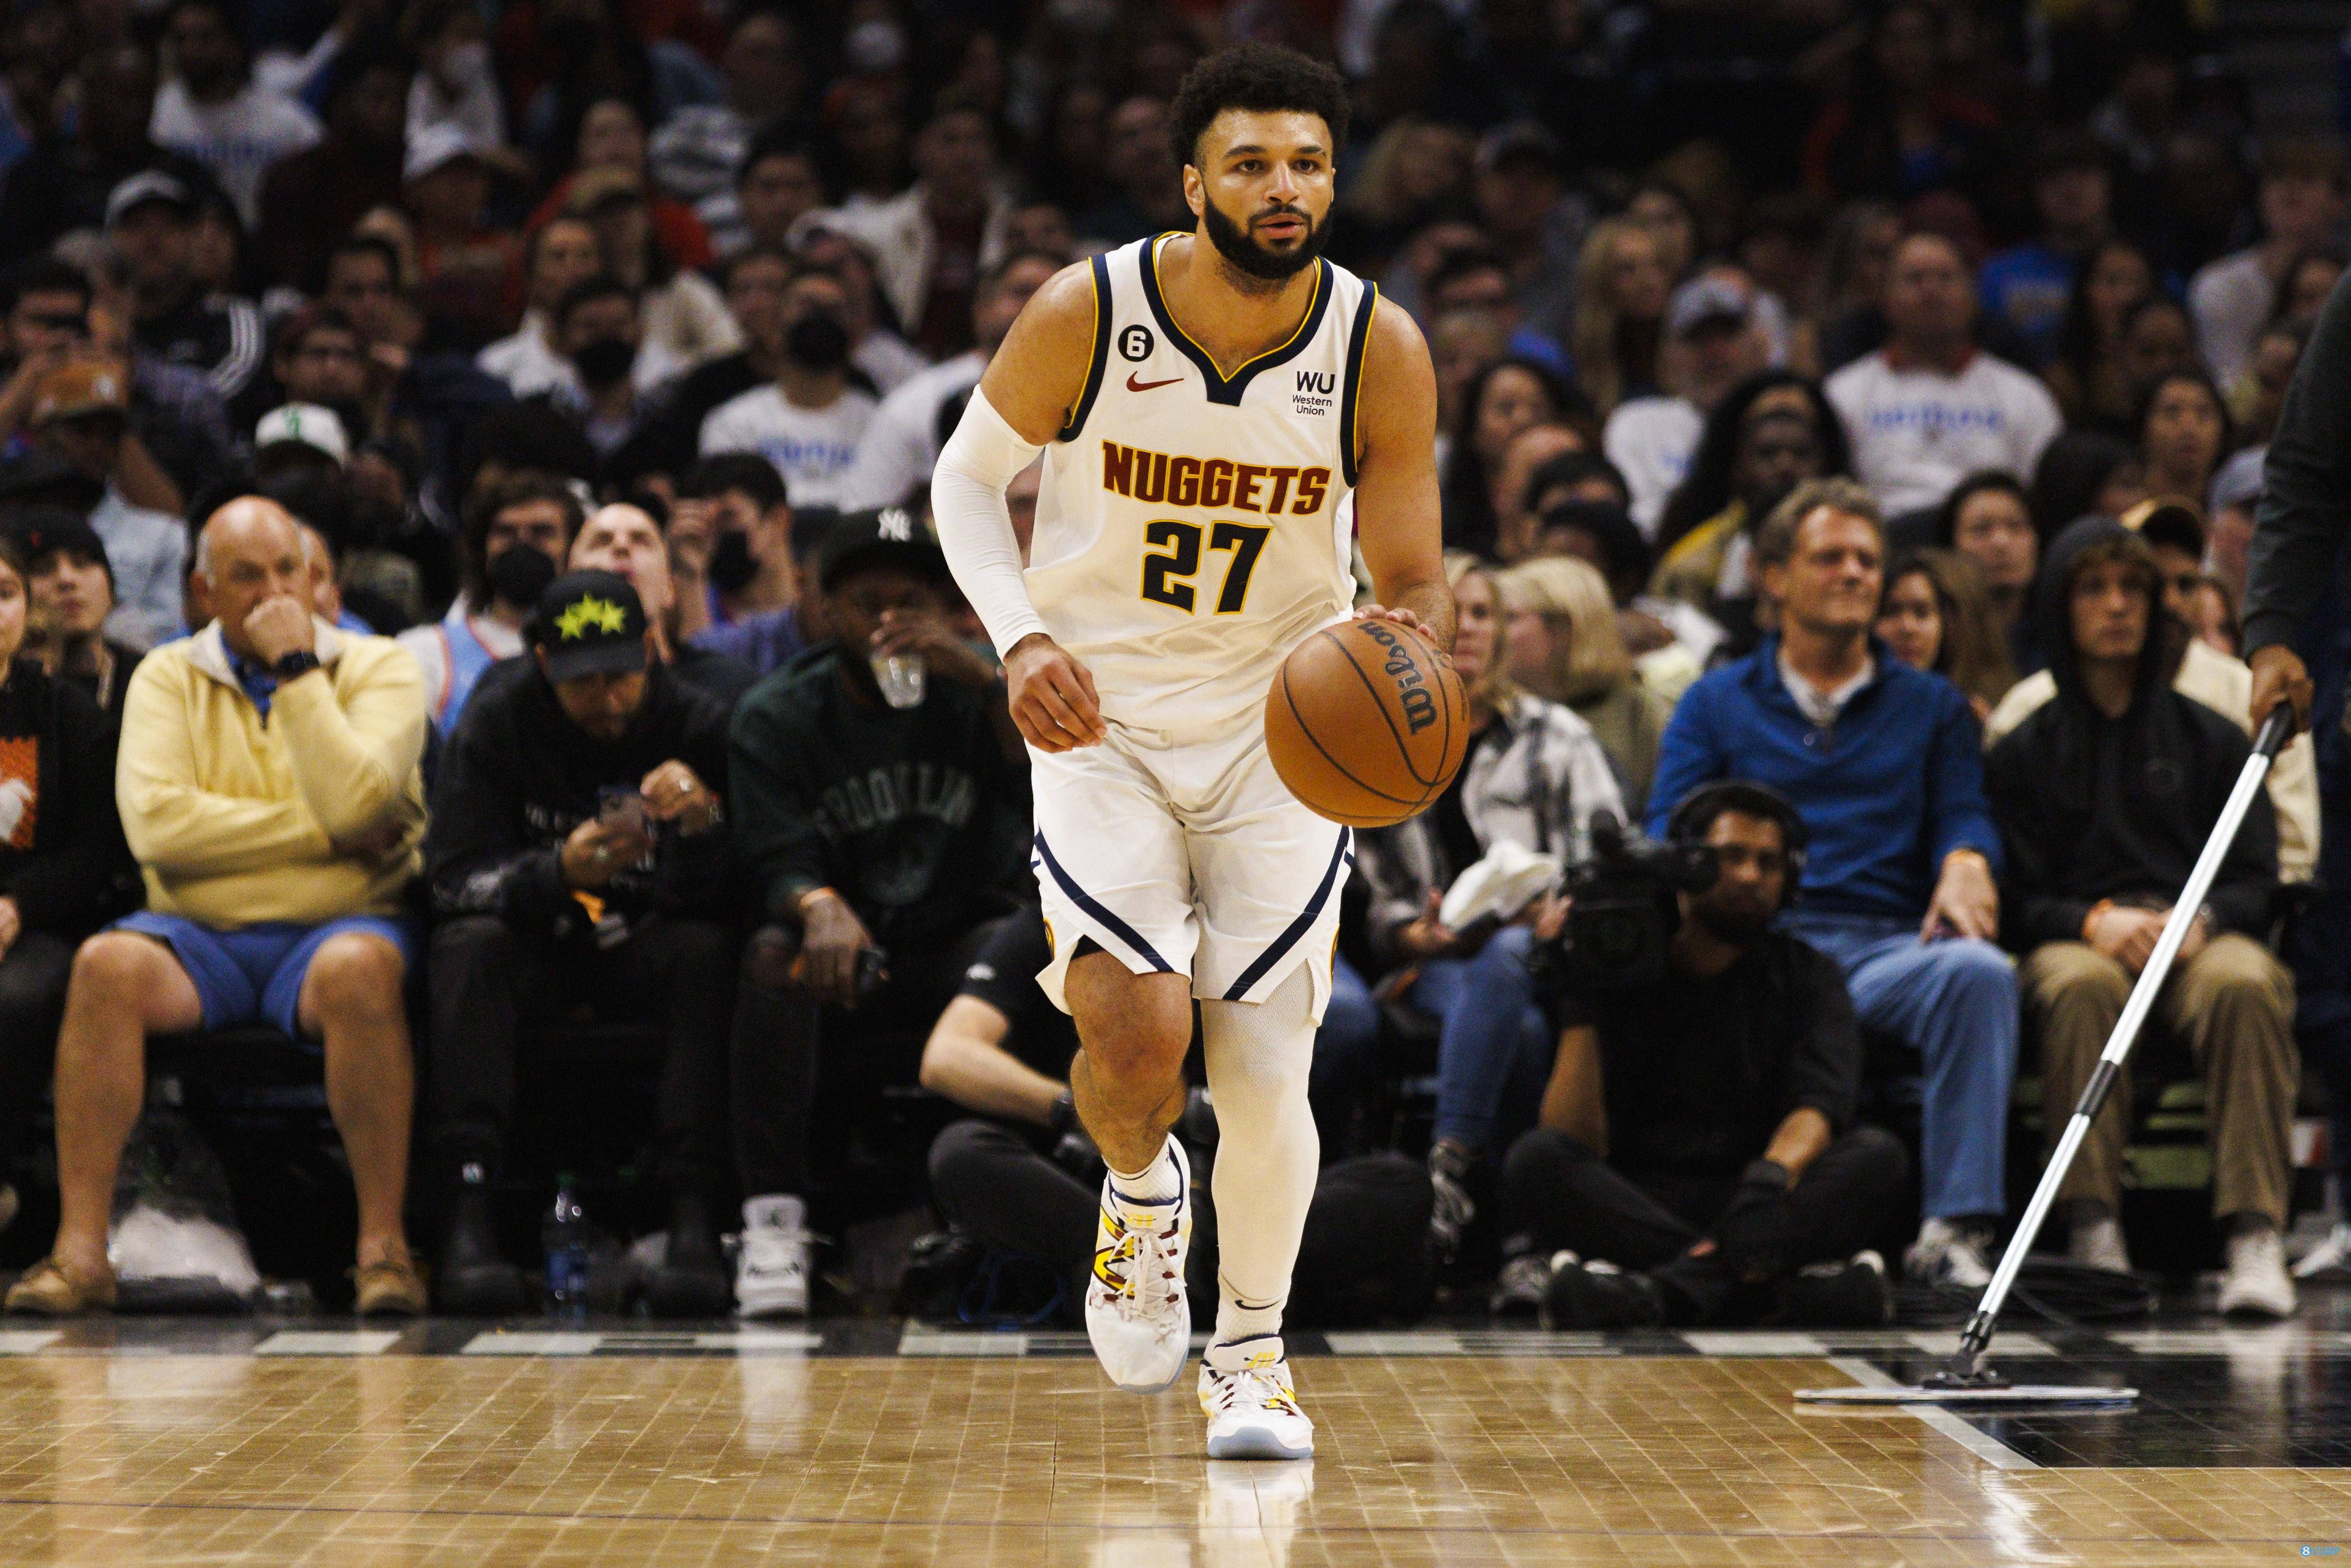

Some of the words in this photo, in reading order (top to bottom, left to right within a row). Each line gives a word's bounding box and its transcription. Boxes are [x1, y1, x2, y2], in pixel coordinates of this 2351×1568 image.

[1127, 331, 1146, 357] 6
[1297, 371, 1335, 394] WU
[1292, 394, 1332, 407] Western
[1296, 405, 1325, 416] Union
[1102, 439, 1332, 516] NUGGETS
[1140, 518, 1274, 617] 27
[1356, 621, 1438, 735] Wilson
